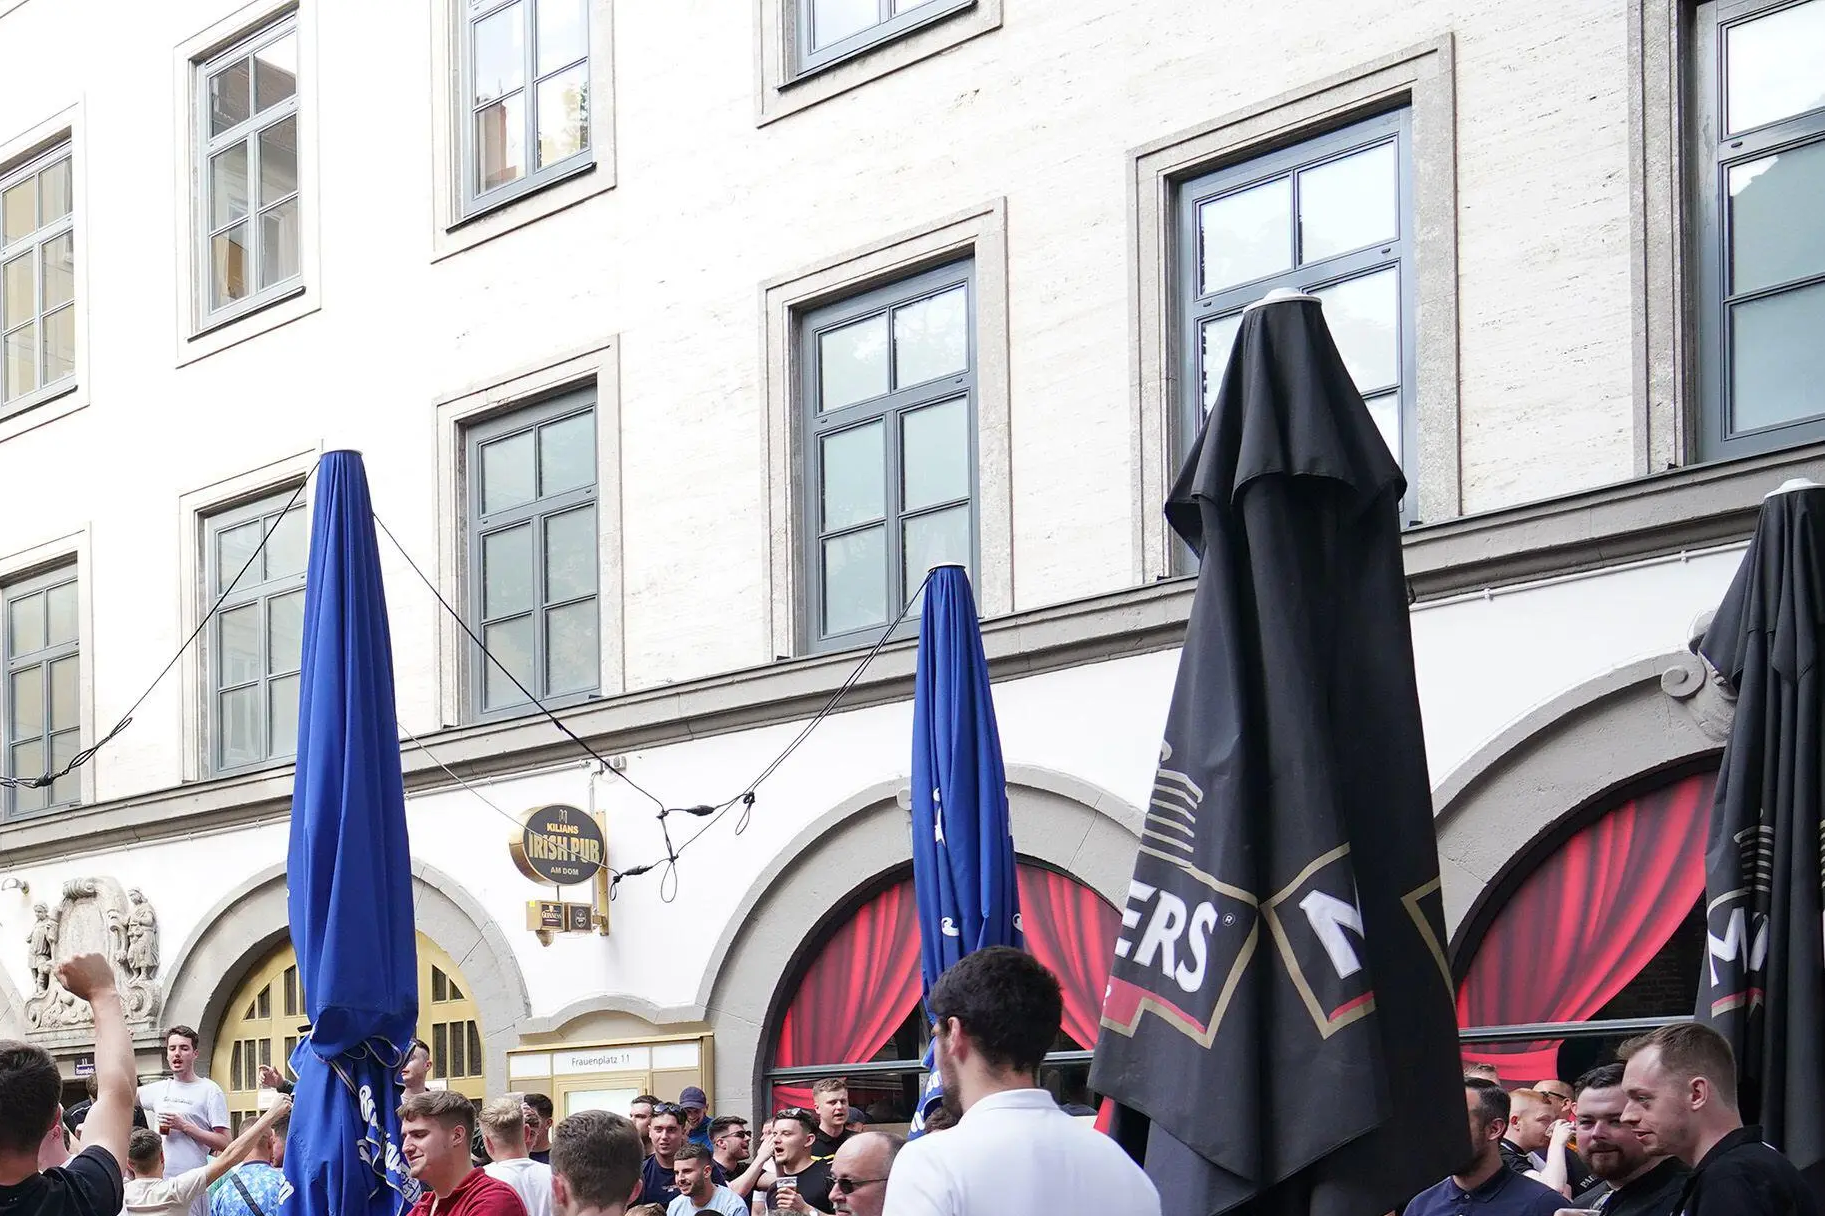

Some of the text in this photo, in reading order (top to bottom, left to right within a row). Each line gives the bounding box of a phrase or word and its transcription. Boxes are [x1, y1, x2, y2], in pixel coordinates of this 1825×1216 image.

[546, 822, 579, 834] KILIANS
[528, 832, 600, 864] IRISH PUB
[550, 866, 579, 876] AM DOM
[571, 1054, 631, 1067] Frauenplatz 11
